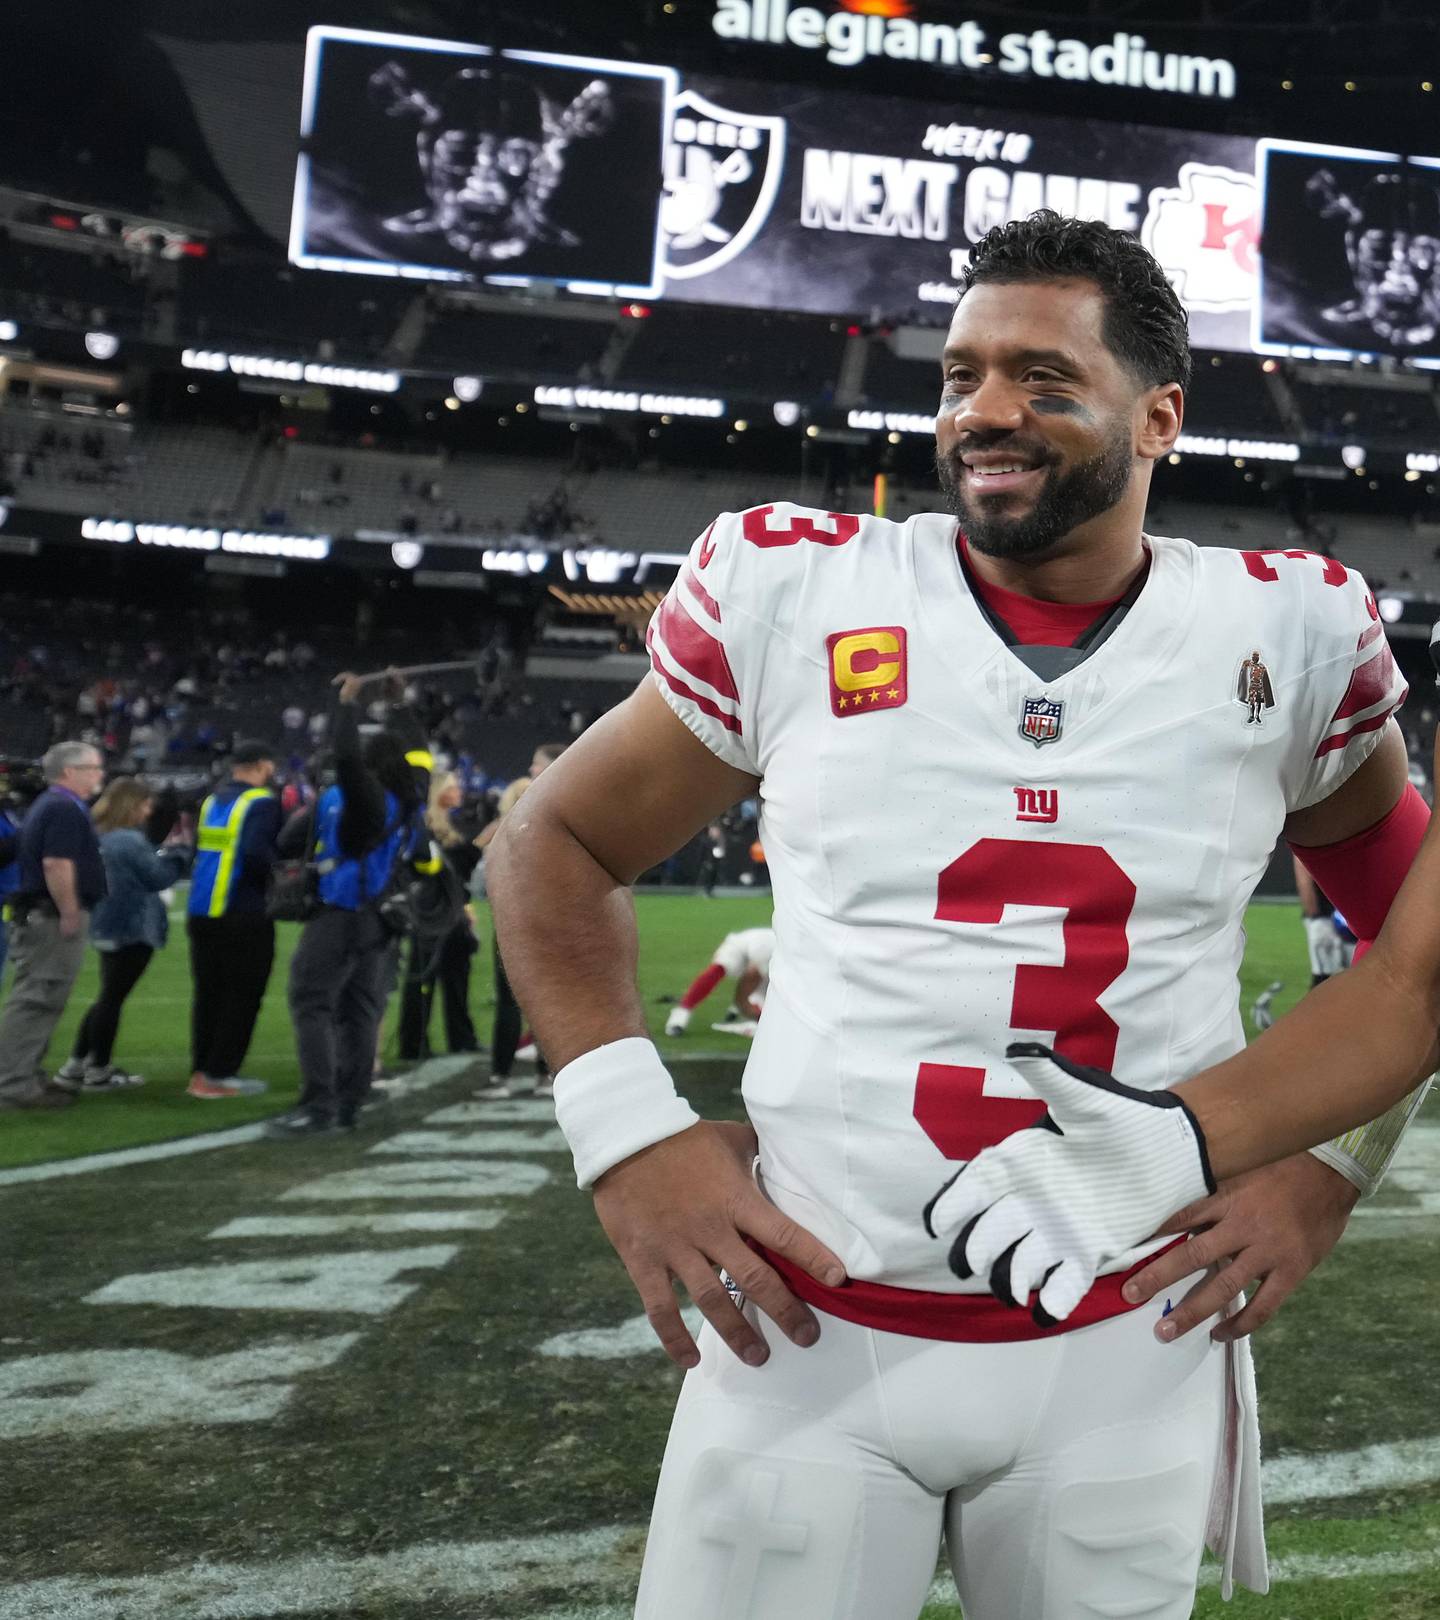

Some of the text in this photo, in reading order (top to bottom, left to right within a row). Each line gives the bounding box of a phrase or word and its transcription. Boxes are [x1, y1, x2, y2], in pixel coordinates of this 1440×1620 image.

[712, 0, 1236, 99] allegiant stadium
[922, 123, 1002, 160] WEEK
[800, 147, 1141, 242] NEXT GAME
[743, 505, 860, 548] 3
[833, 631, 900, 692] C
[1025, 715, 1055, 738] NFL
[1013, 786, 1058, 823] ny
[912, 838, 1137, 1162] 3
